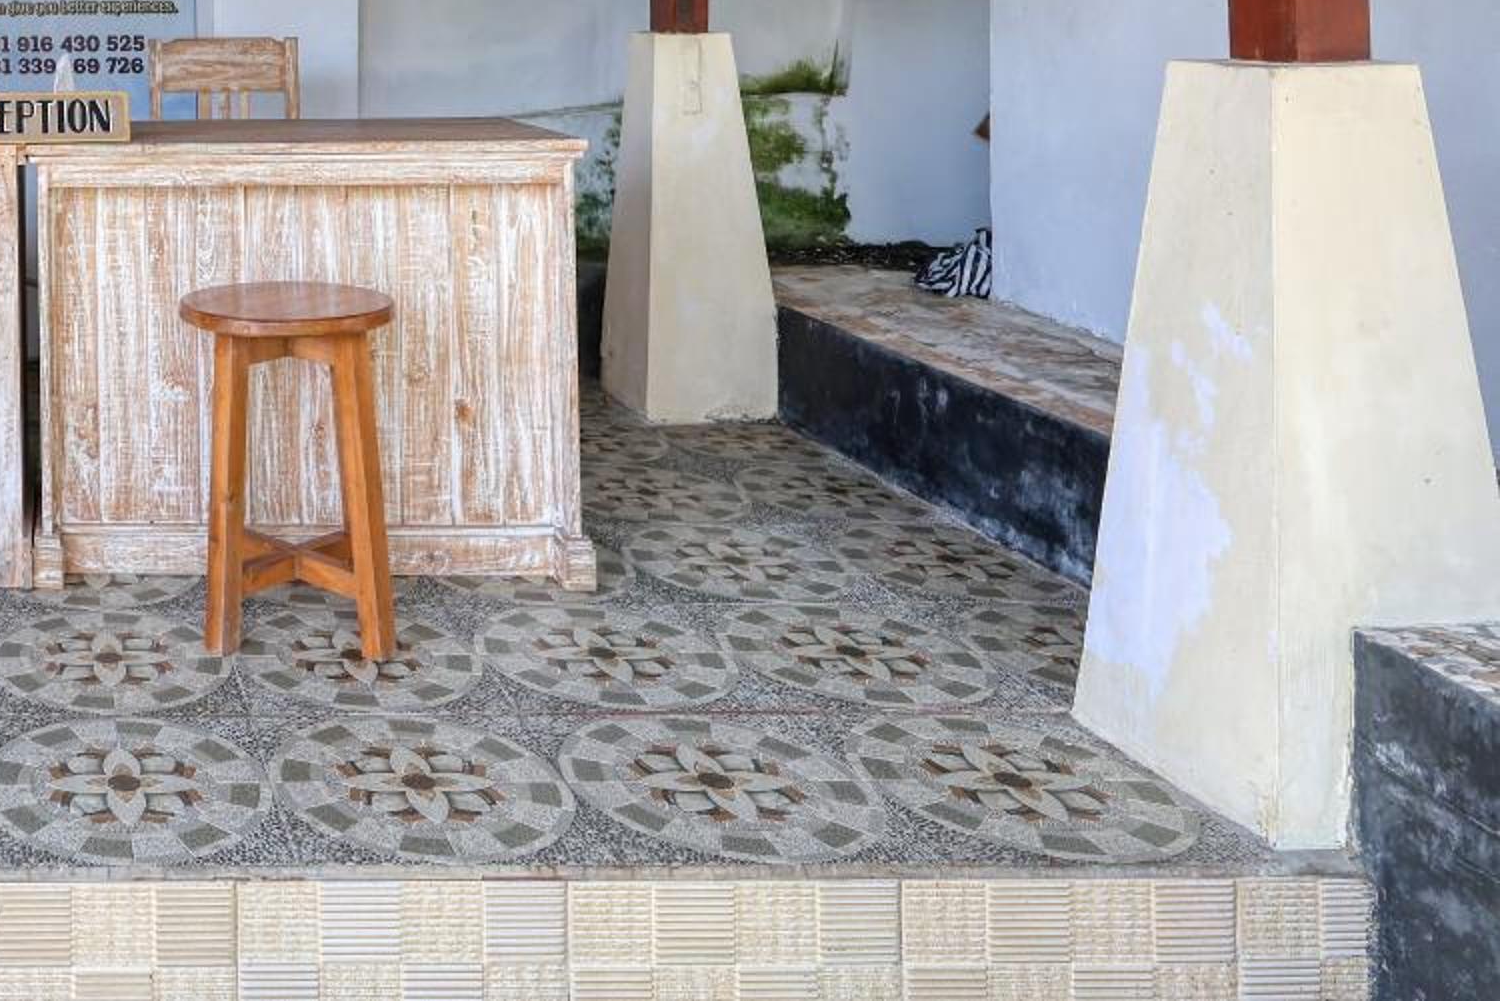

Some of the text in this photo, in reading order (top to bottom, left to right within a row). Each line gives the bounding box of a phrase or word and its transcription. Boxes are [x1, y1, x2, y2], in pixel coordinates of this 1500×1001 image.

[17, 35, 53, 52] 916
[59, 35, 100, 53] 430
[107, 34, 146, 52] 525
[18, 58, 57, 75] 339
[62, 57, 100, 75] 69
[106, 56, 145, 74] 726
